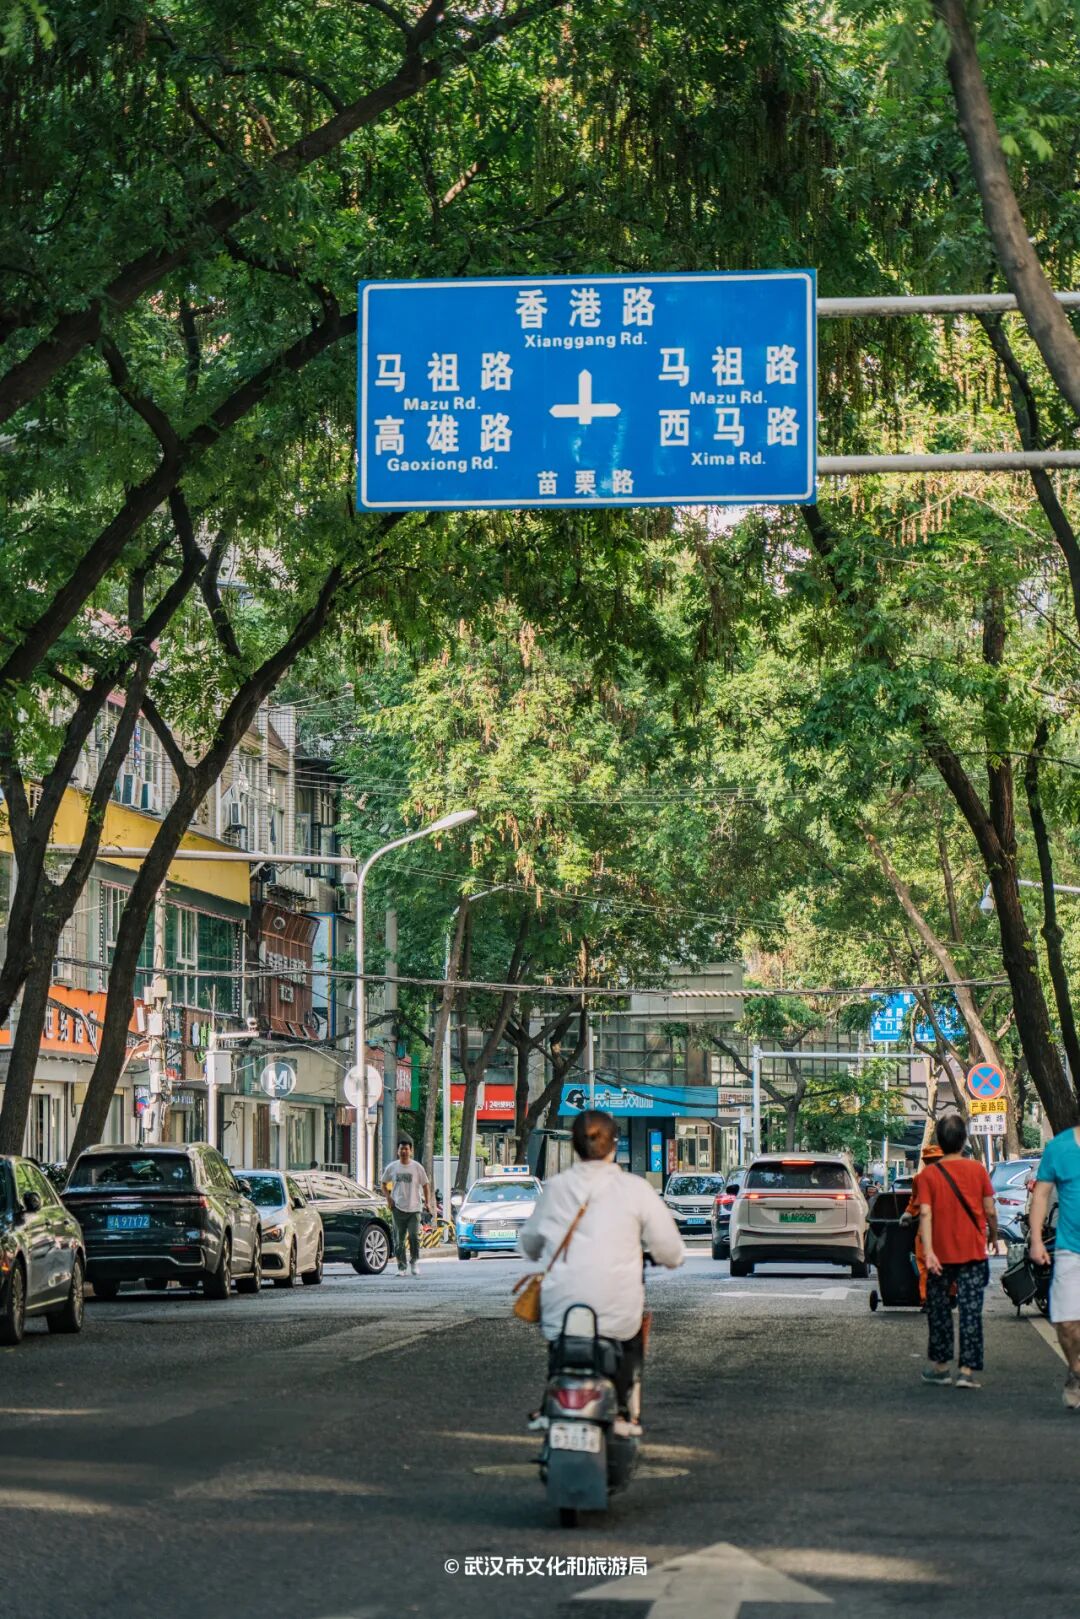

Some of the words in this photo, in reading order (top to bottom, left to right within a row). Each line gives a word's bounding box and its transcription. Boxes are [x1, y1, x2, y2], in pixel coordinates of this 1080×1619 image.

[516, 287, 655, 329] 香港路
[525, 334, 616, 349] Xianggang
[621, 332, 649, 346] Rd.
[375, 352, 513, 392] 马祖路
[658, 345, 799, 387] 马祖路
[404, 397, 449, 411] Mazu
[454, 396, 481, 410] Rd.
[690, 391, 736, 405] Mazu
[741, 390, 768, 404] Rd.
[374, 413, 513, 456] 高雄路
[658, 406, 800, 447] 西马路
[387, 458, 467, 473] Gaoxiong
[472, 456, 498, 471] Rd.
[692, 452, 735, 465] Xima
[740, 451, 766, 465] Rd.
[537, 470, 634, 496] 苗栗路
[971, 1101, 1005, 1112] 严管路段
